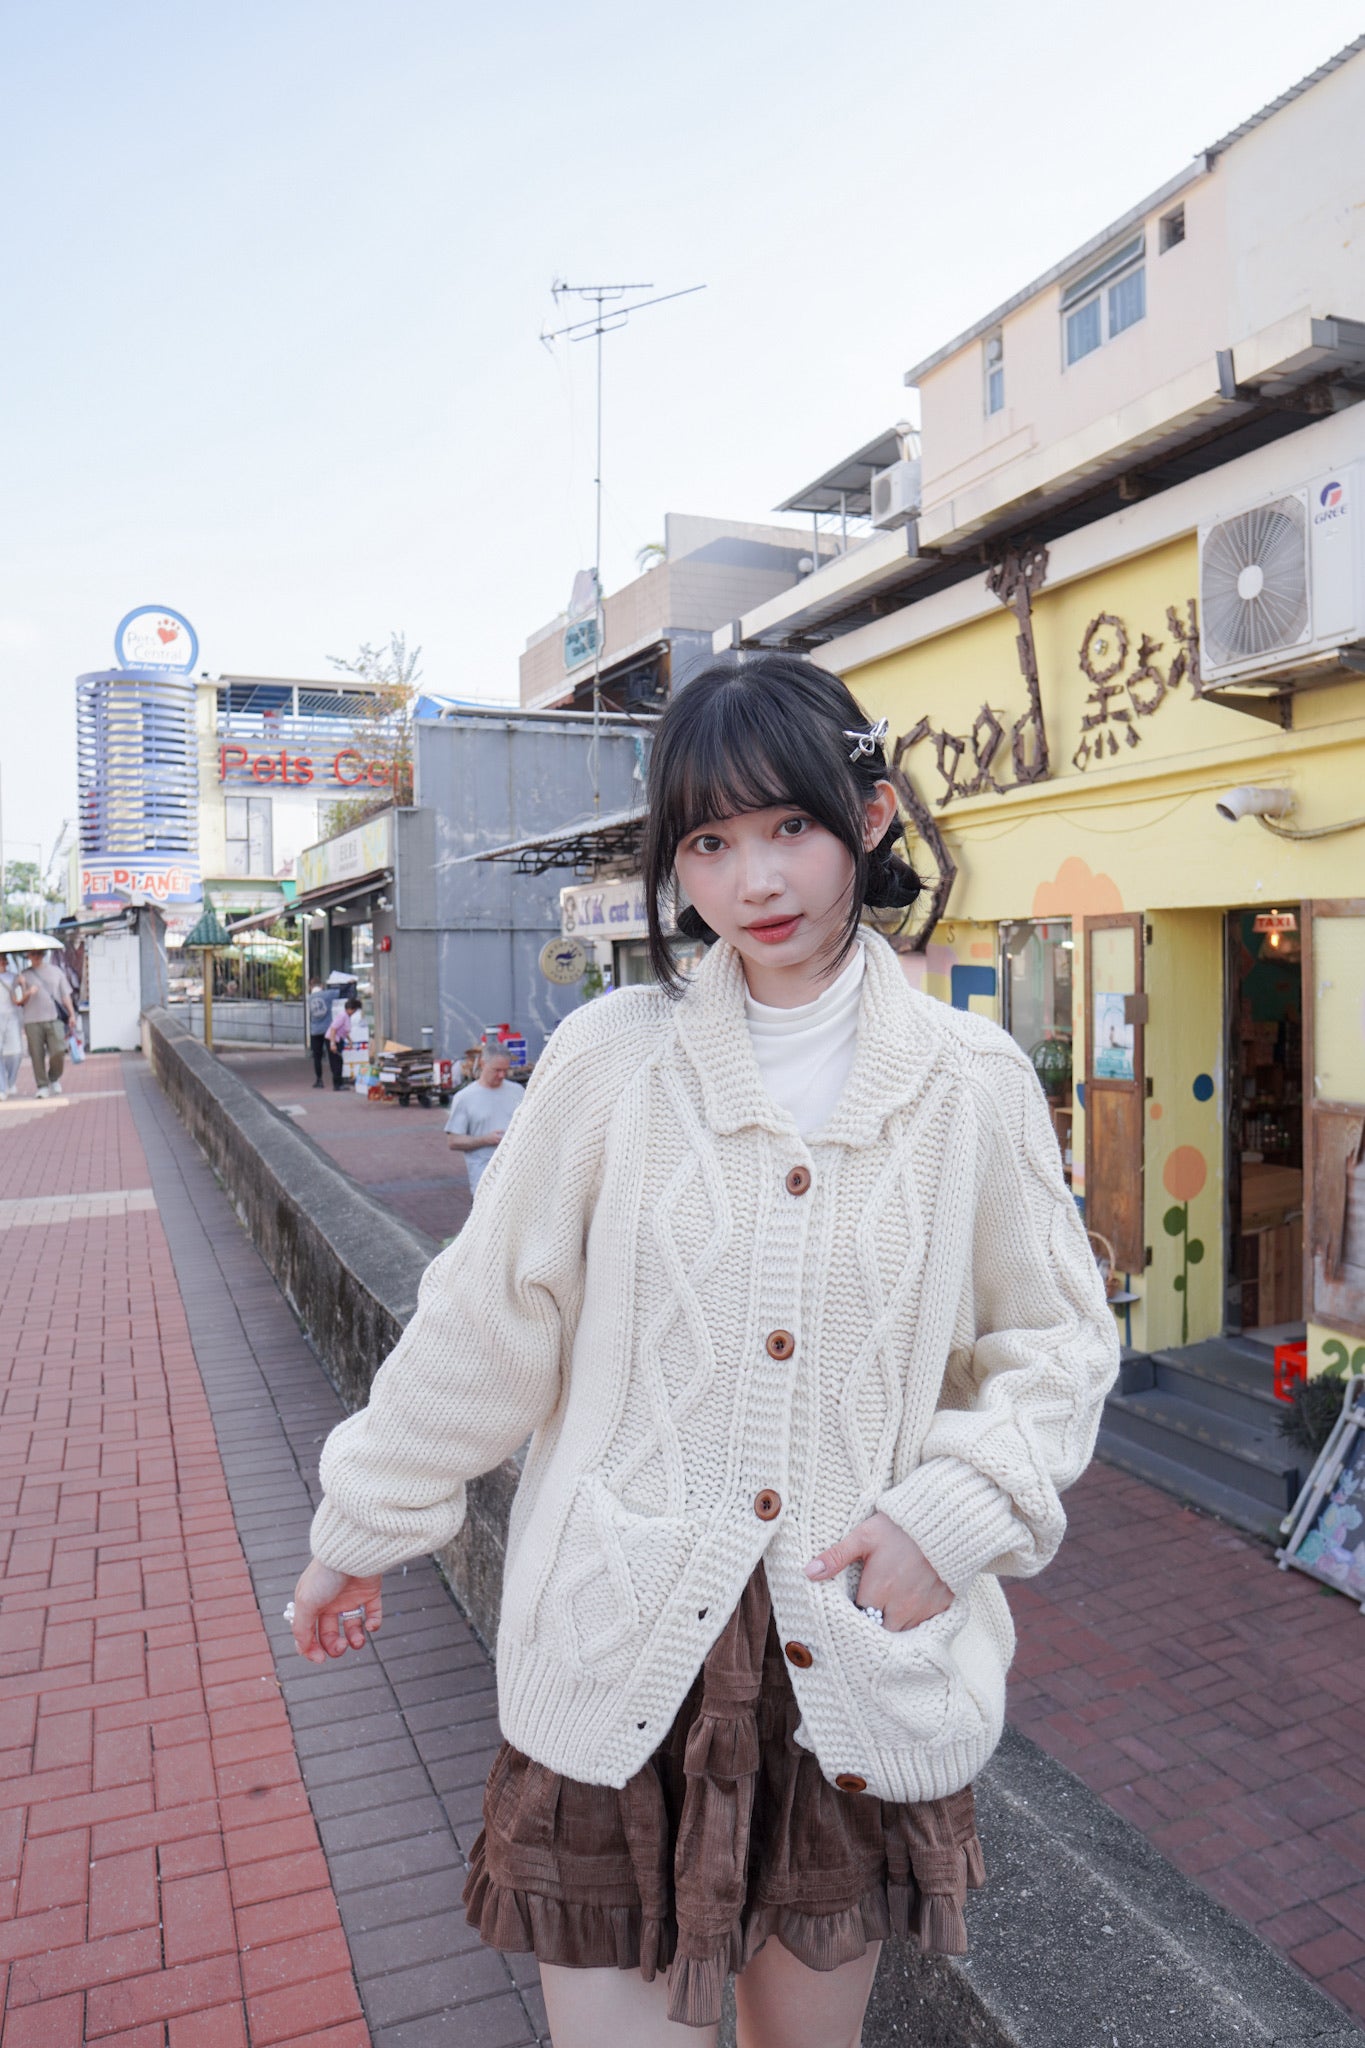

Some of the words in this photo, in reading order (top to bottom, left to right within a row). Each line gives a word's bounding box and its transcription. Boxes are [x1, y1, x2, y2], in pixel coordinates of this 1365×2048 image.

[1313, 503, 1351, 526] GREE
[220, 745, 314, 785] Pets
[83, 871, 110, 894] PET
[113, 867, 191, 898] PLANET
[609, 900, 630, 922] cut
[1257, 917, 1291, 928] TAXI
